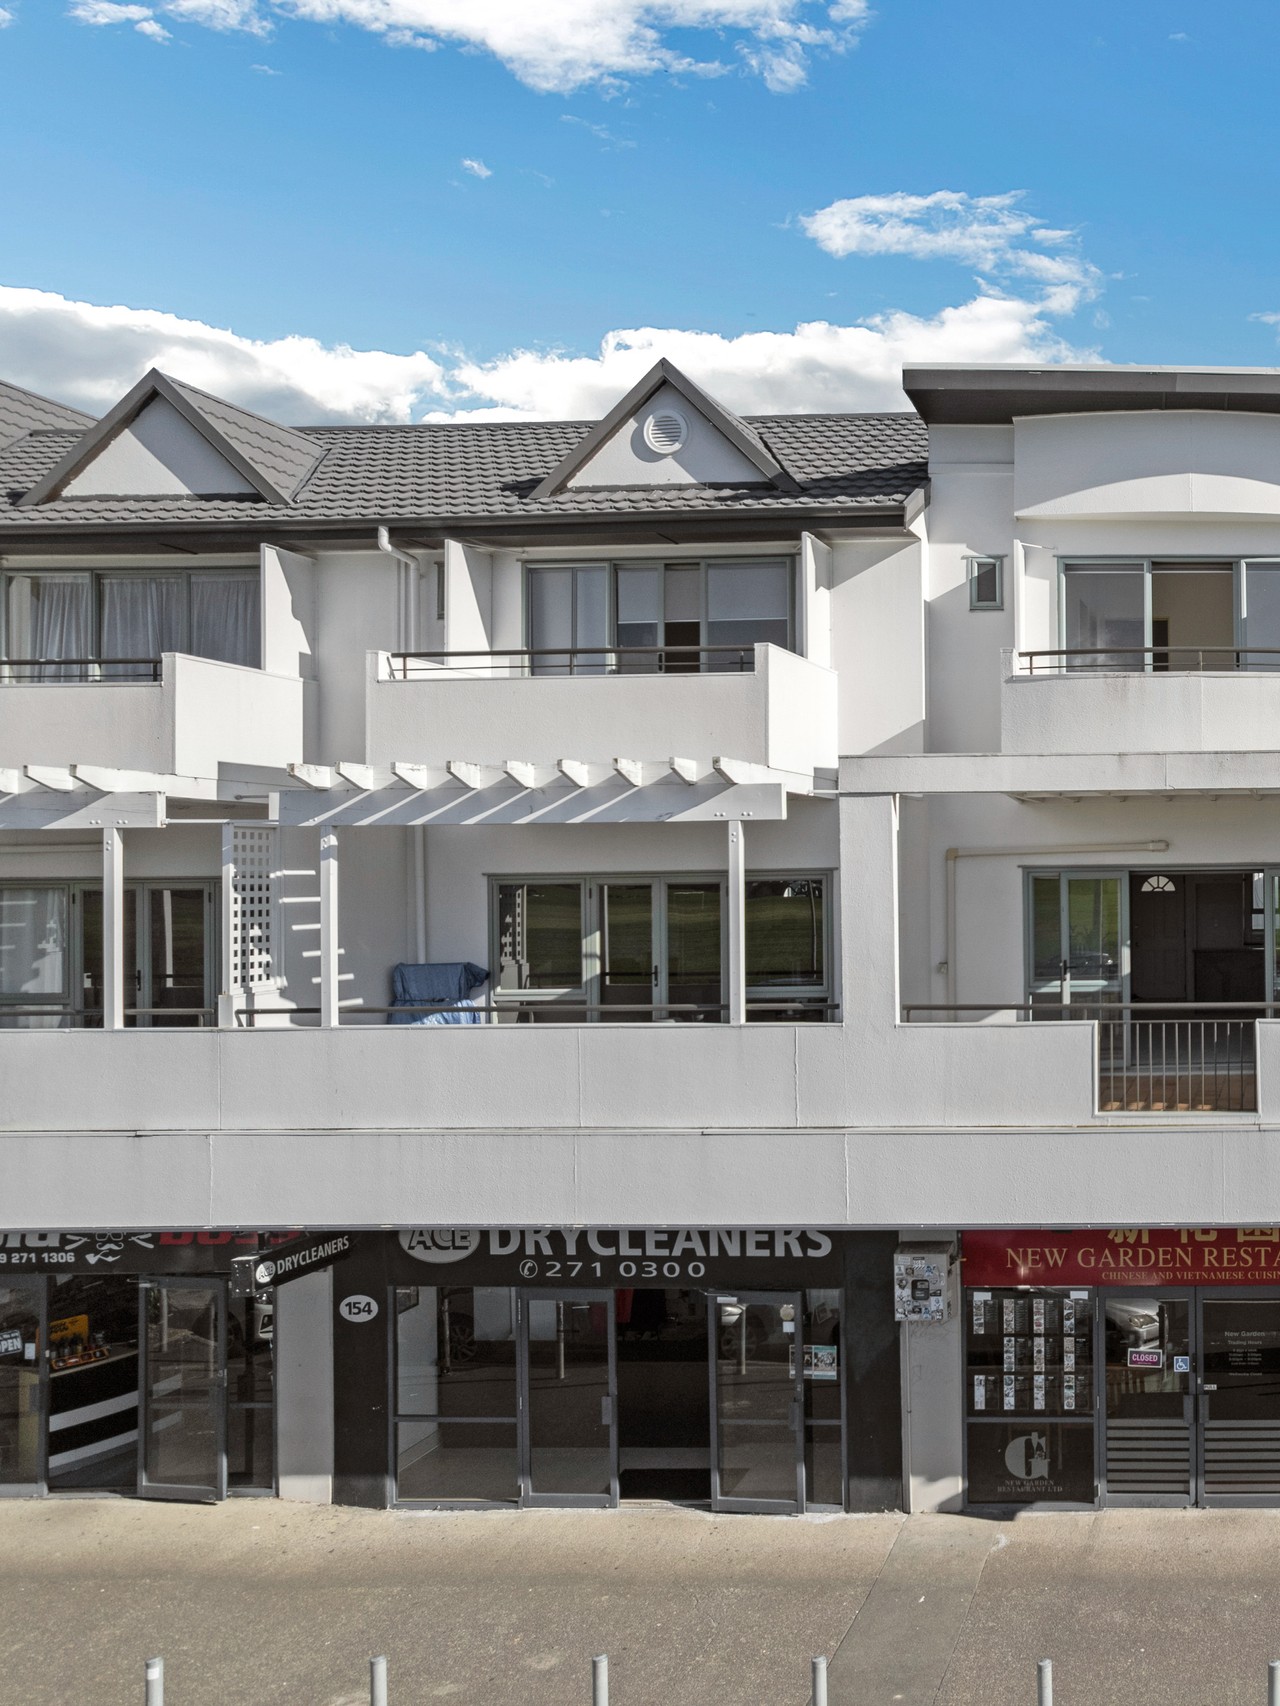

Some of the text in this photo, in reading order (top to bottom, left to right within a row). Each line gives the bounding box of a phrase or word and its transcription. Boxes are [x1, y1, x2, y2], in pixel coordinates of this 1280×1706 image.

[489, 1230, 833, 1257] DRYCLEANERS
[11, 1253, 36, 1263] 271
[41, 1253, 75, 1263] 1306
[276, 1236, 349, 1275] DRYCLEANERS
[1006, 1249, 1068, 1268] NEW
[1077, 1248, 1191, 1268] GARDEN
[258, 1264, 274, 1280] ACE
[545, 1261, 706, 1278] 271 0300
[1102, 1272, 1147, 1280] CHINESE
[1152, 1271, 1173, 1280] AND
[1177, 1271, 1244, 1280] VIETNAMESE
[344, 1301, 373, 1316] 154
[1132, 1353, 1158, 1362] CLOSED
